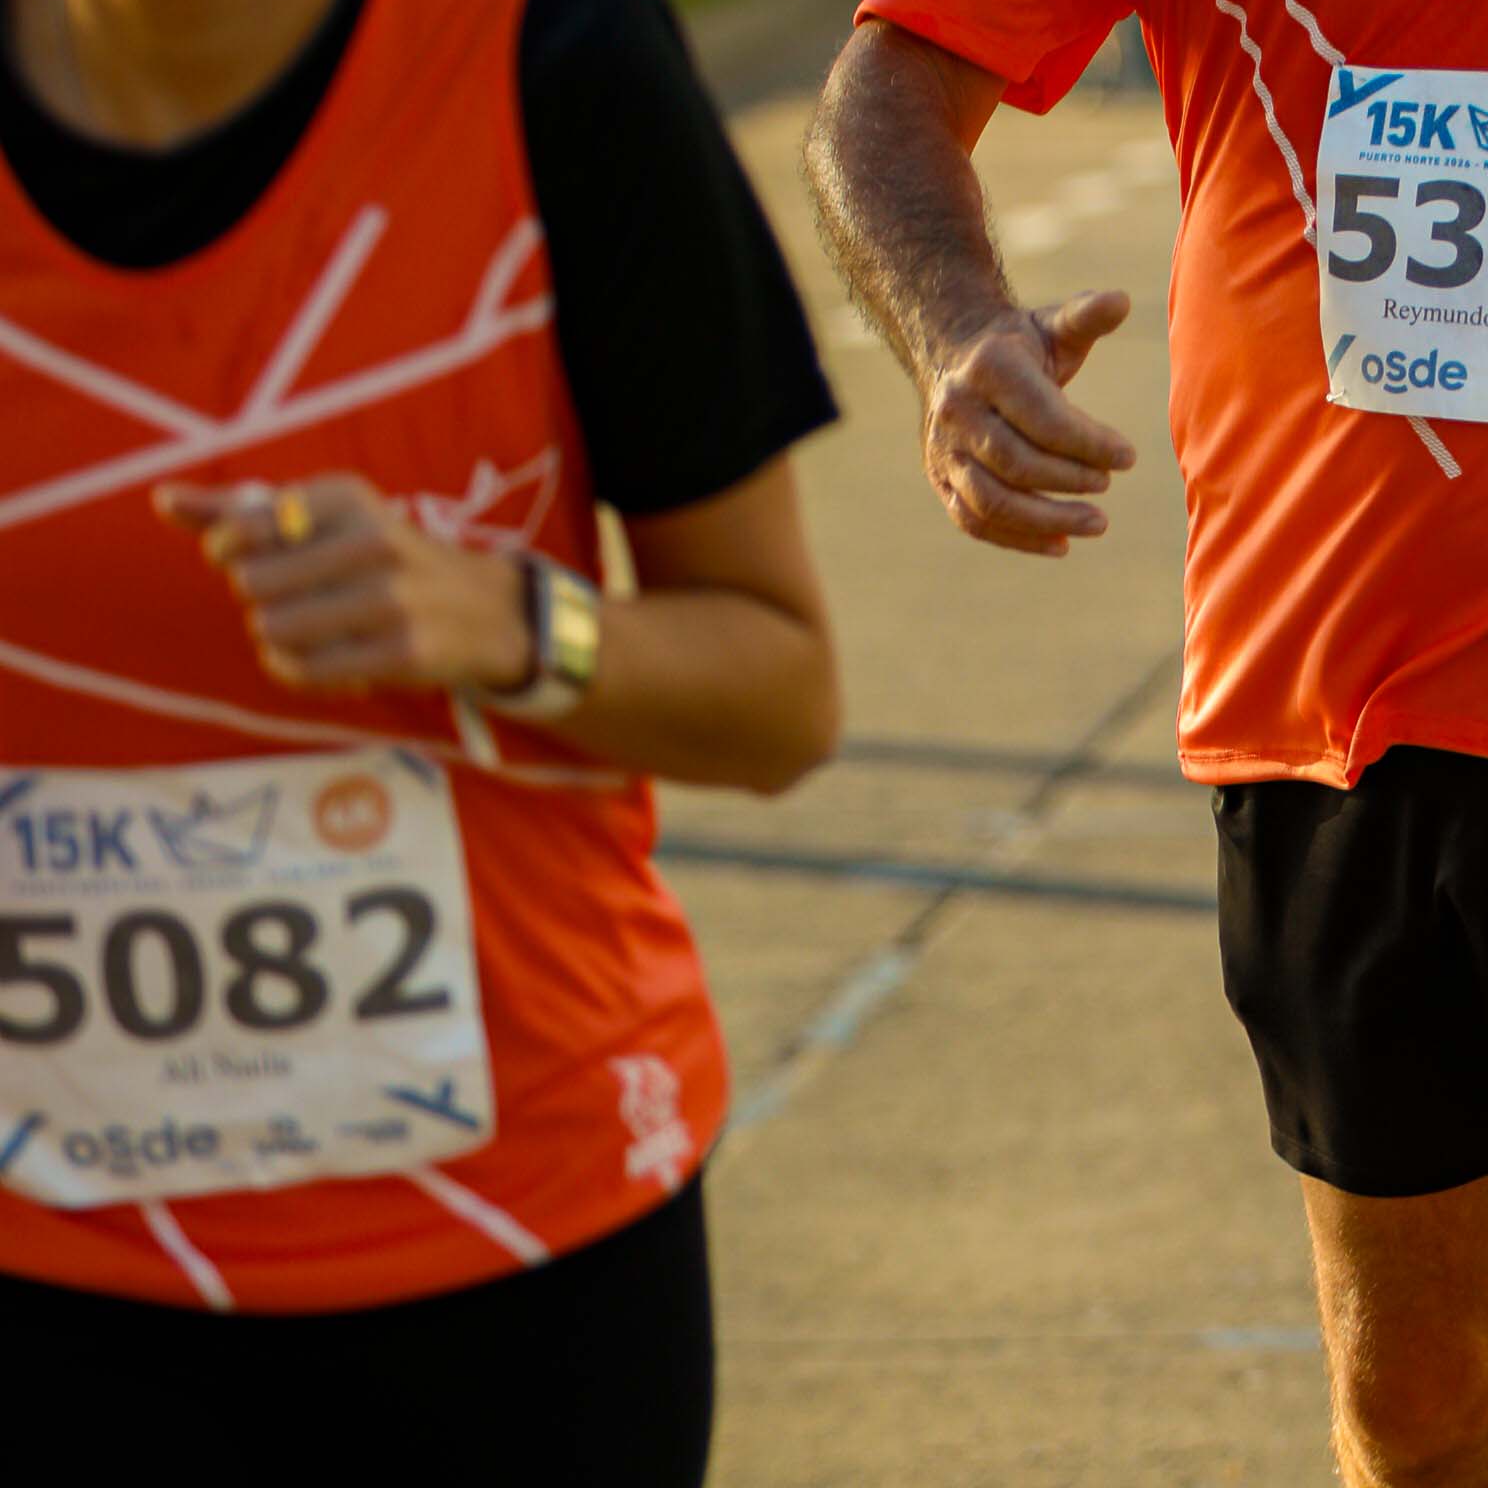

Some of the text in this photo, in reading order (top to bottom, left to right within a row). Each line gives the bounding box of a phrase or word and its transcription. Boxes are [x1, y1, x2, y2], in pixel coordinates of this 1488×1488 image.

[1366, 100, 1461, 151] 15K
[1358, 151, 1401, 163] PUERTO
[1404, 155, 1440, 166] NORTE
[1361, 348, 1468, 393] osde
[14, 811, 137, 873] 15K
[0, 885, 452, 1047] 5082
